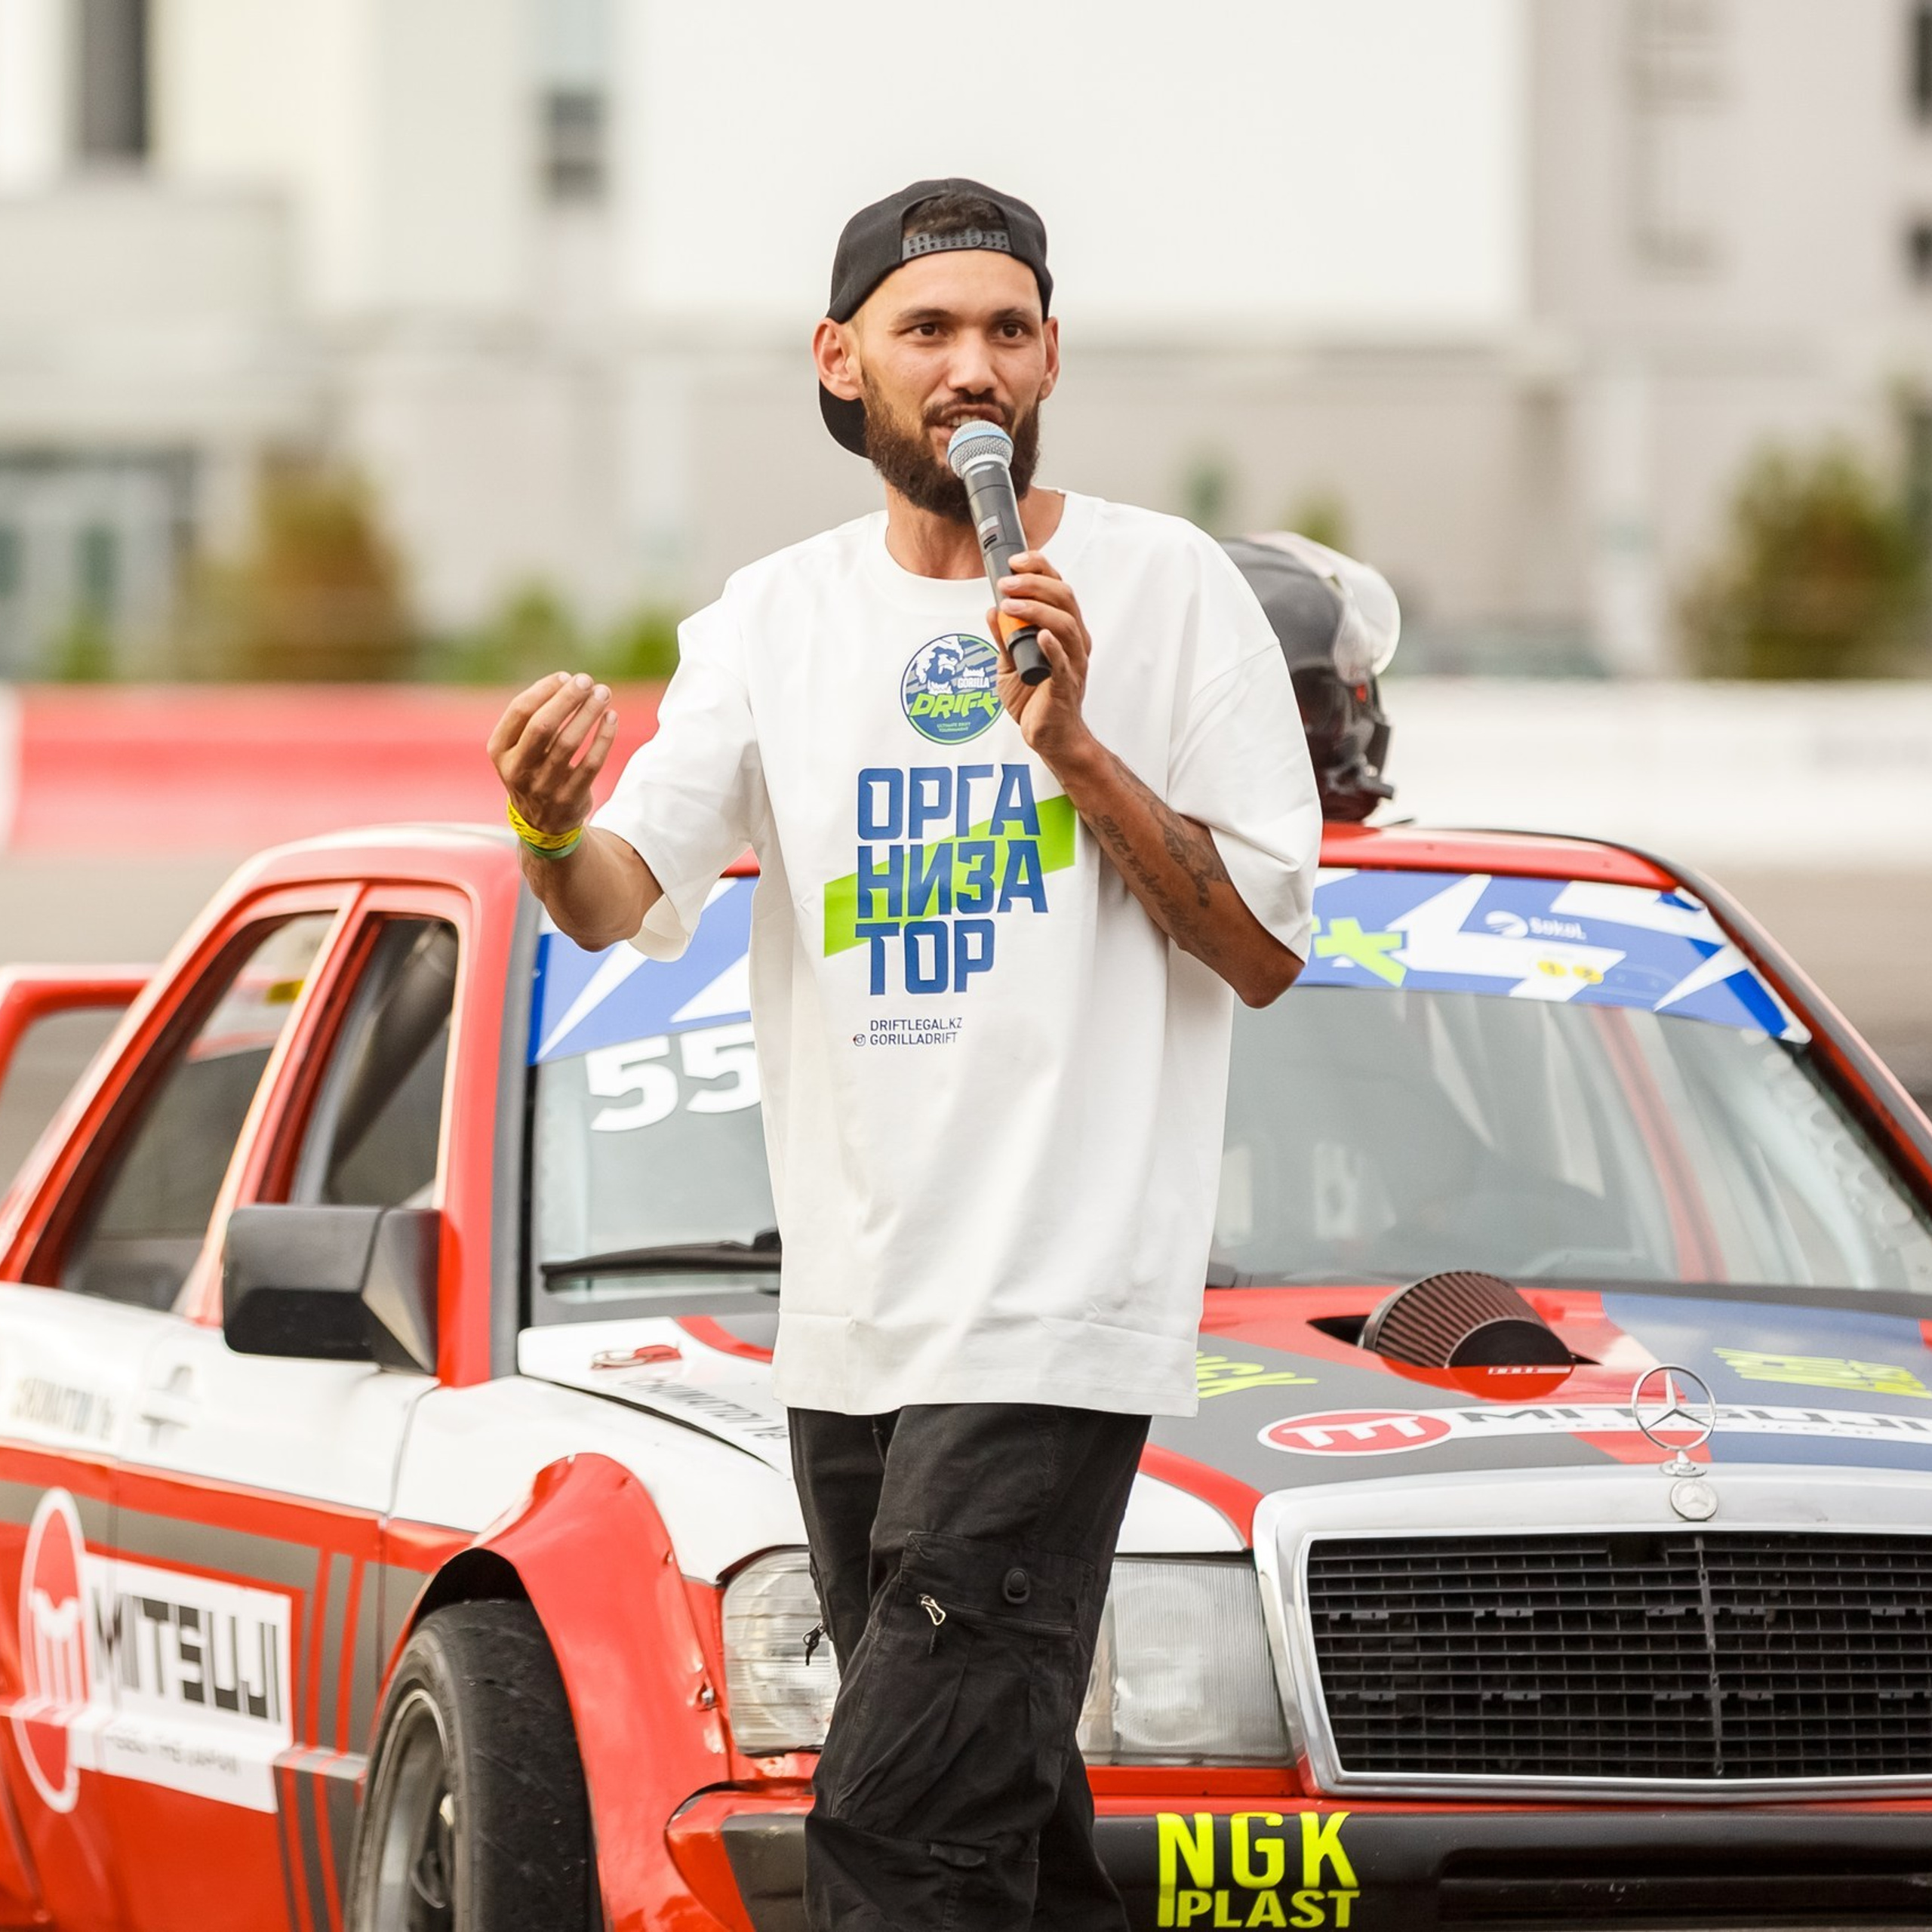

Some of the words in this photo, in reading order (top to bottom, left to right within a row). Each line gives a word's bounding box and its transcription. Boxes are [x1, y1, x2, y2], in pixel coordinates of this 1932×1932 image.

[957, 677, 990, 689] GORILLA
[909, 691, 999, 718] DRIFT
[857, 763, 1041, 841] ОРГА
[857, 839, 1049, 918] НИЗА
[854, 918, 995, 996] ТОР
[869, 1017, 963, 1032] DRIFTLEGAL.KZ
[869, 1032, 958, 1045] GORILLADRIFT
[1156, 1811, 1358, 1927] NGK
[1177, 1889, 1361, 1928] PLAST
